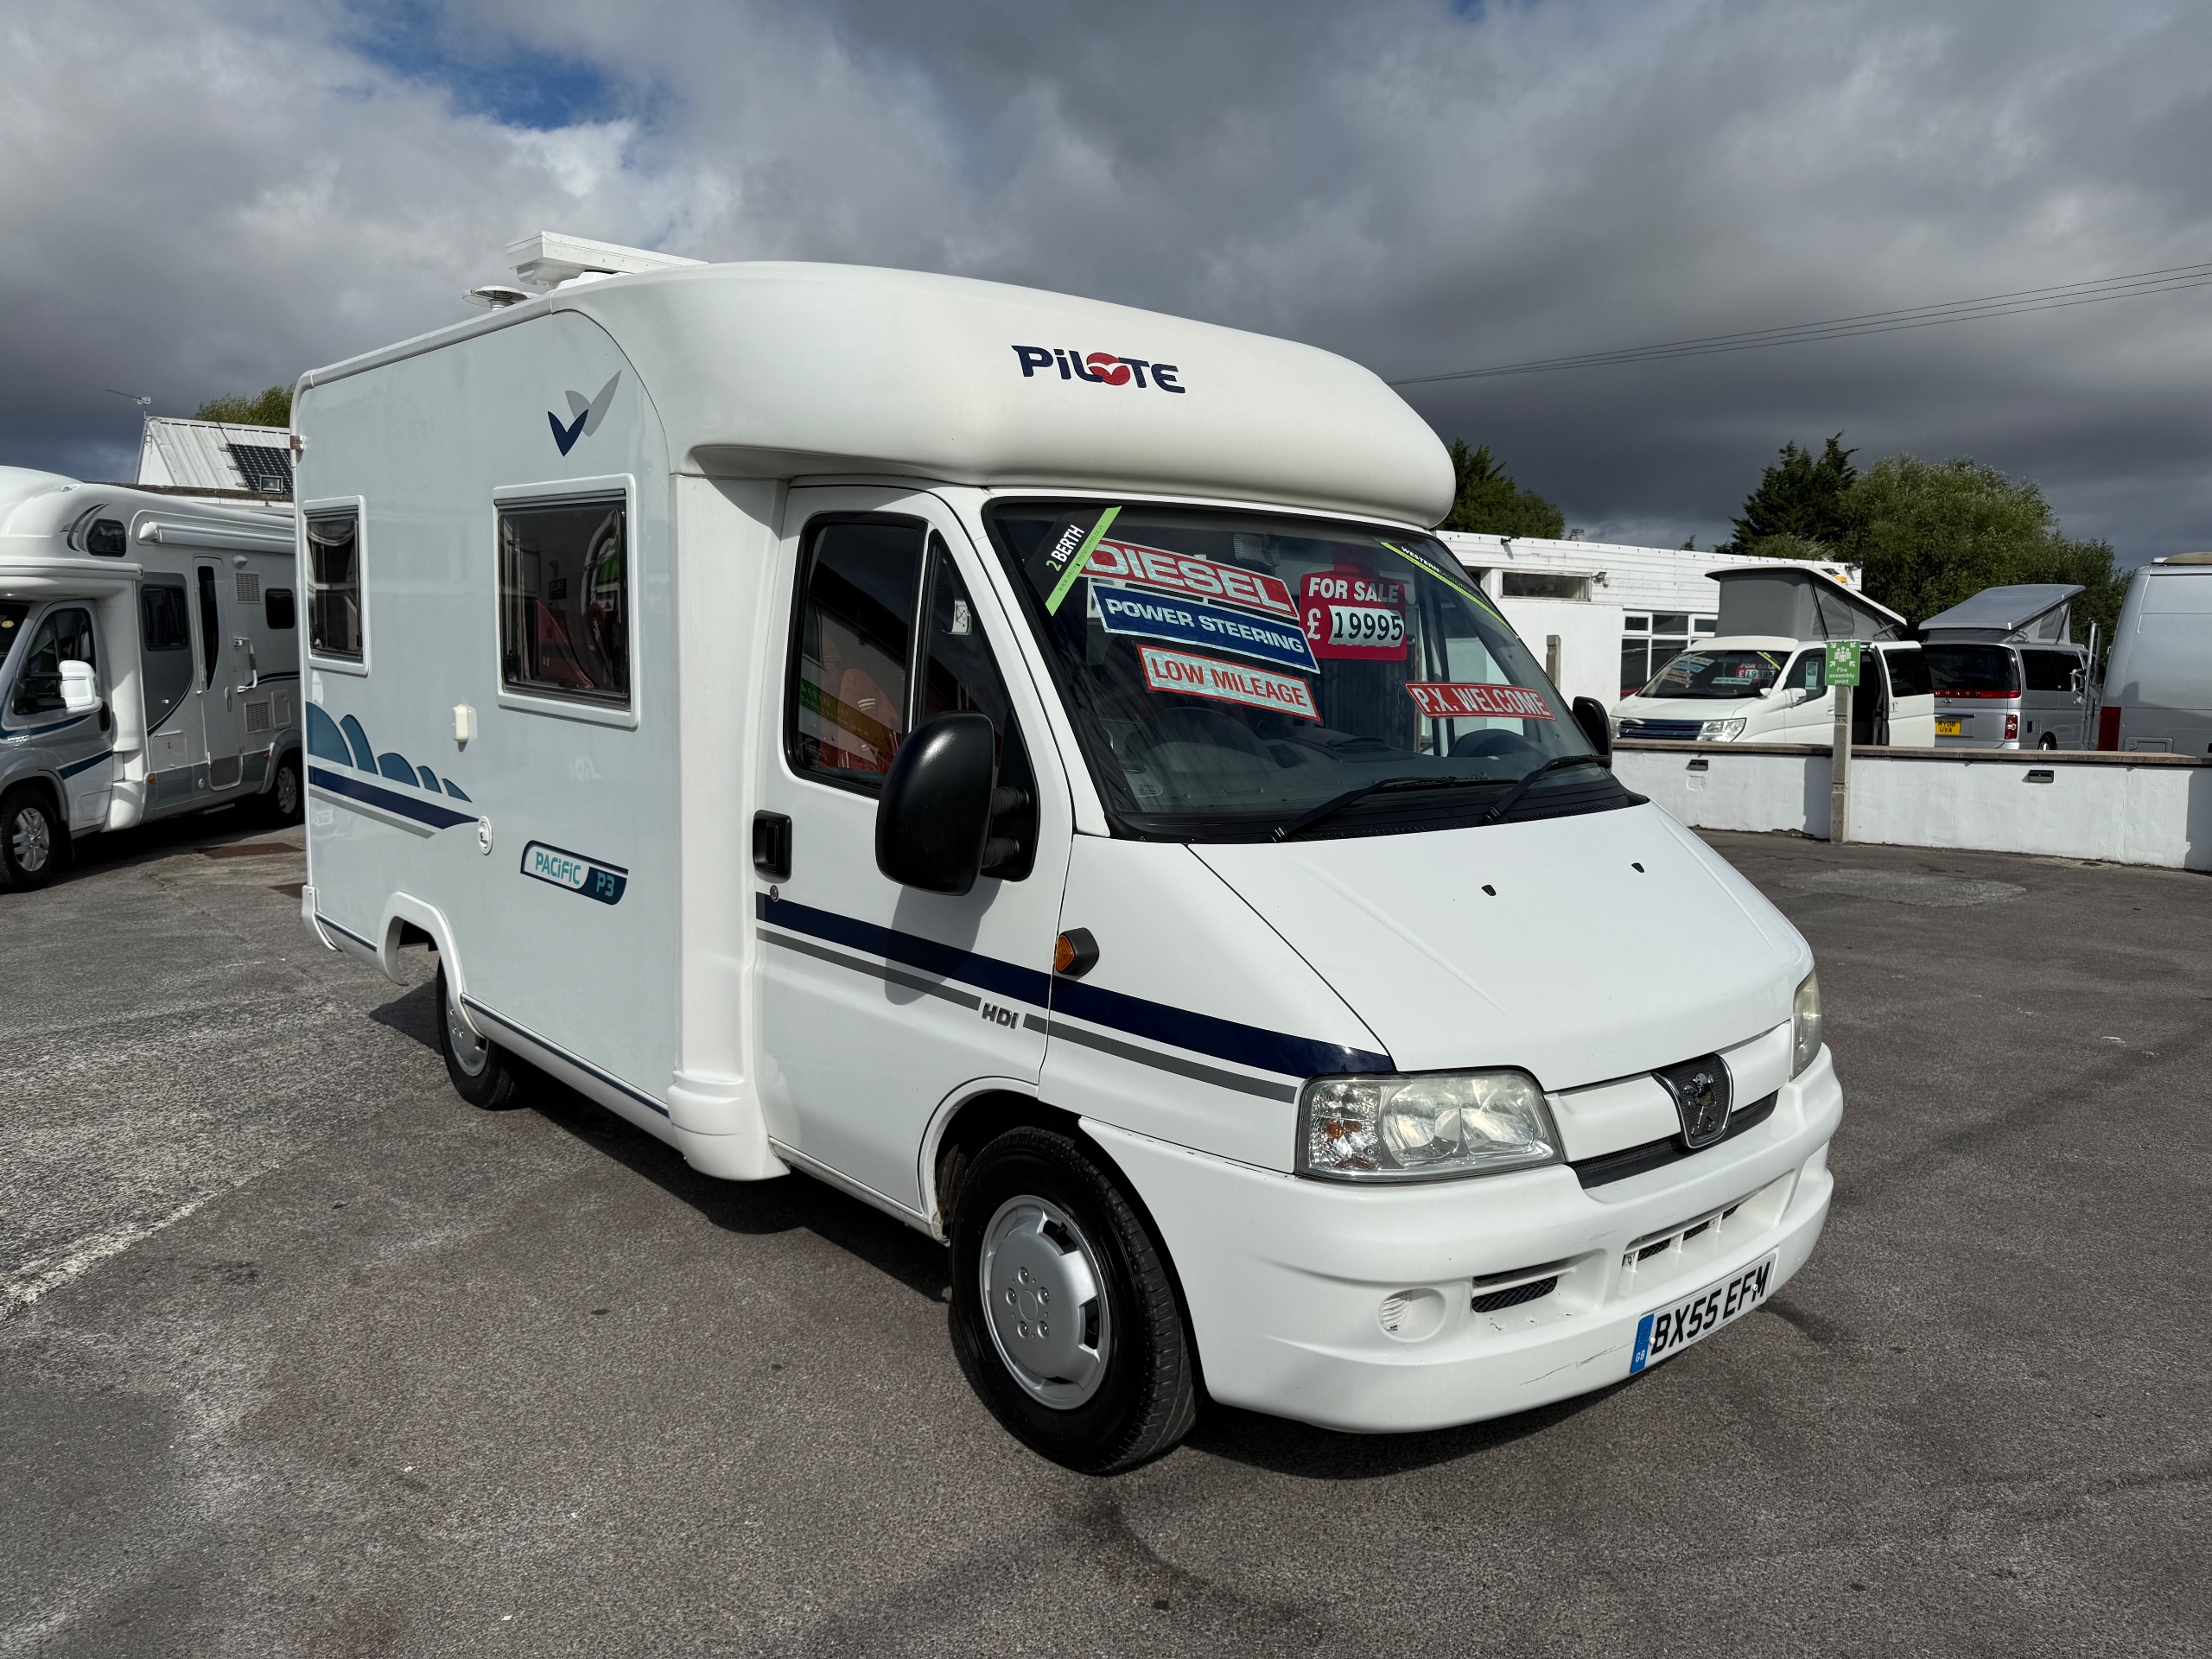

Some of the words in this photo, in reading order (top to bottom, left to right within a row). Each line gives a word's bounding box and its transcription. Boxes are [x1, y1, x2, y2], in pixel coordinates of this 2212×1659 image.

[1051, 524, 1085, 563] BERTH
[1046, 559, 1063, 572] 2
[1085, 543, 1291, 612] DIESEL
[1308, 576, 1348, 600] FOR
[1353, 581, 1399, 603] SALE
[1104, 598, 1196, 628] POWER
[1198, 614, 1305, 654] STEERING
[1306, 607, 1321, 640] £
[1333, 611, 1403, 641] 19995
[1150, 657, 1205, 685] LOW
[1210, 668, 1308, 708] MILEAGE
[1411, 687, 1459, 713] P.X.
[1450, 688, 1551, 716] WELCOME
[595, 871, 615, 897] P3
[1650, 1287, 1722, 1356] BX55
[1722, 1261, 1771, 1319] EFM
[1635, 1349, 1646, 1363] GB
